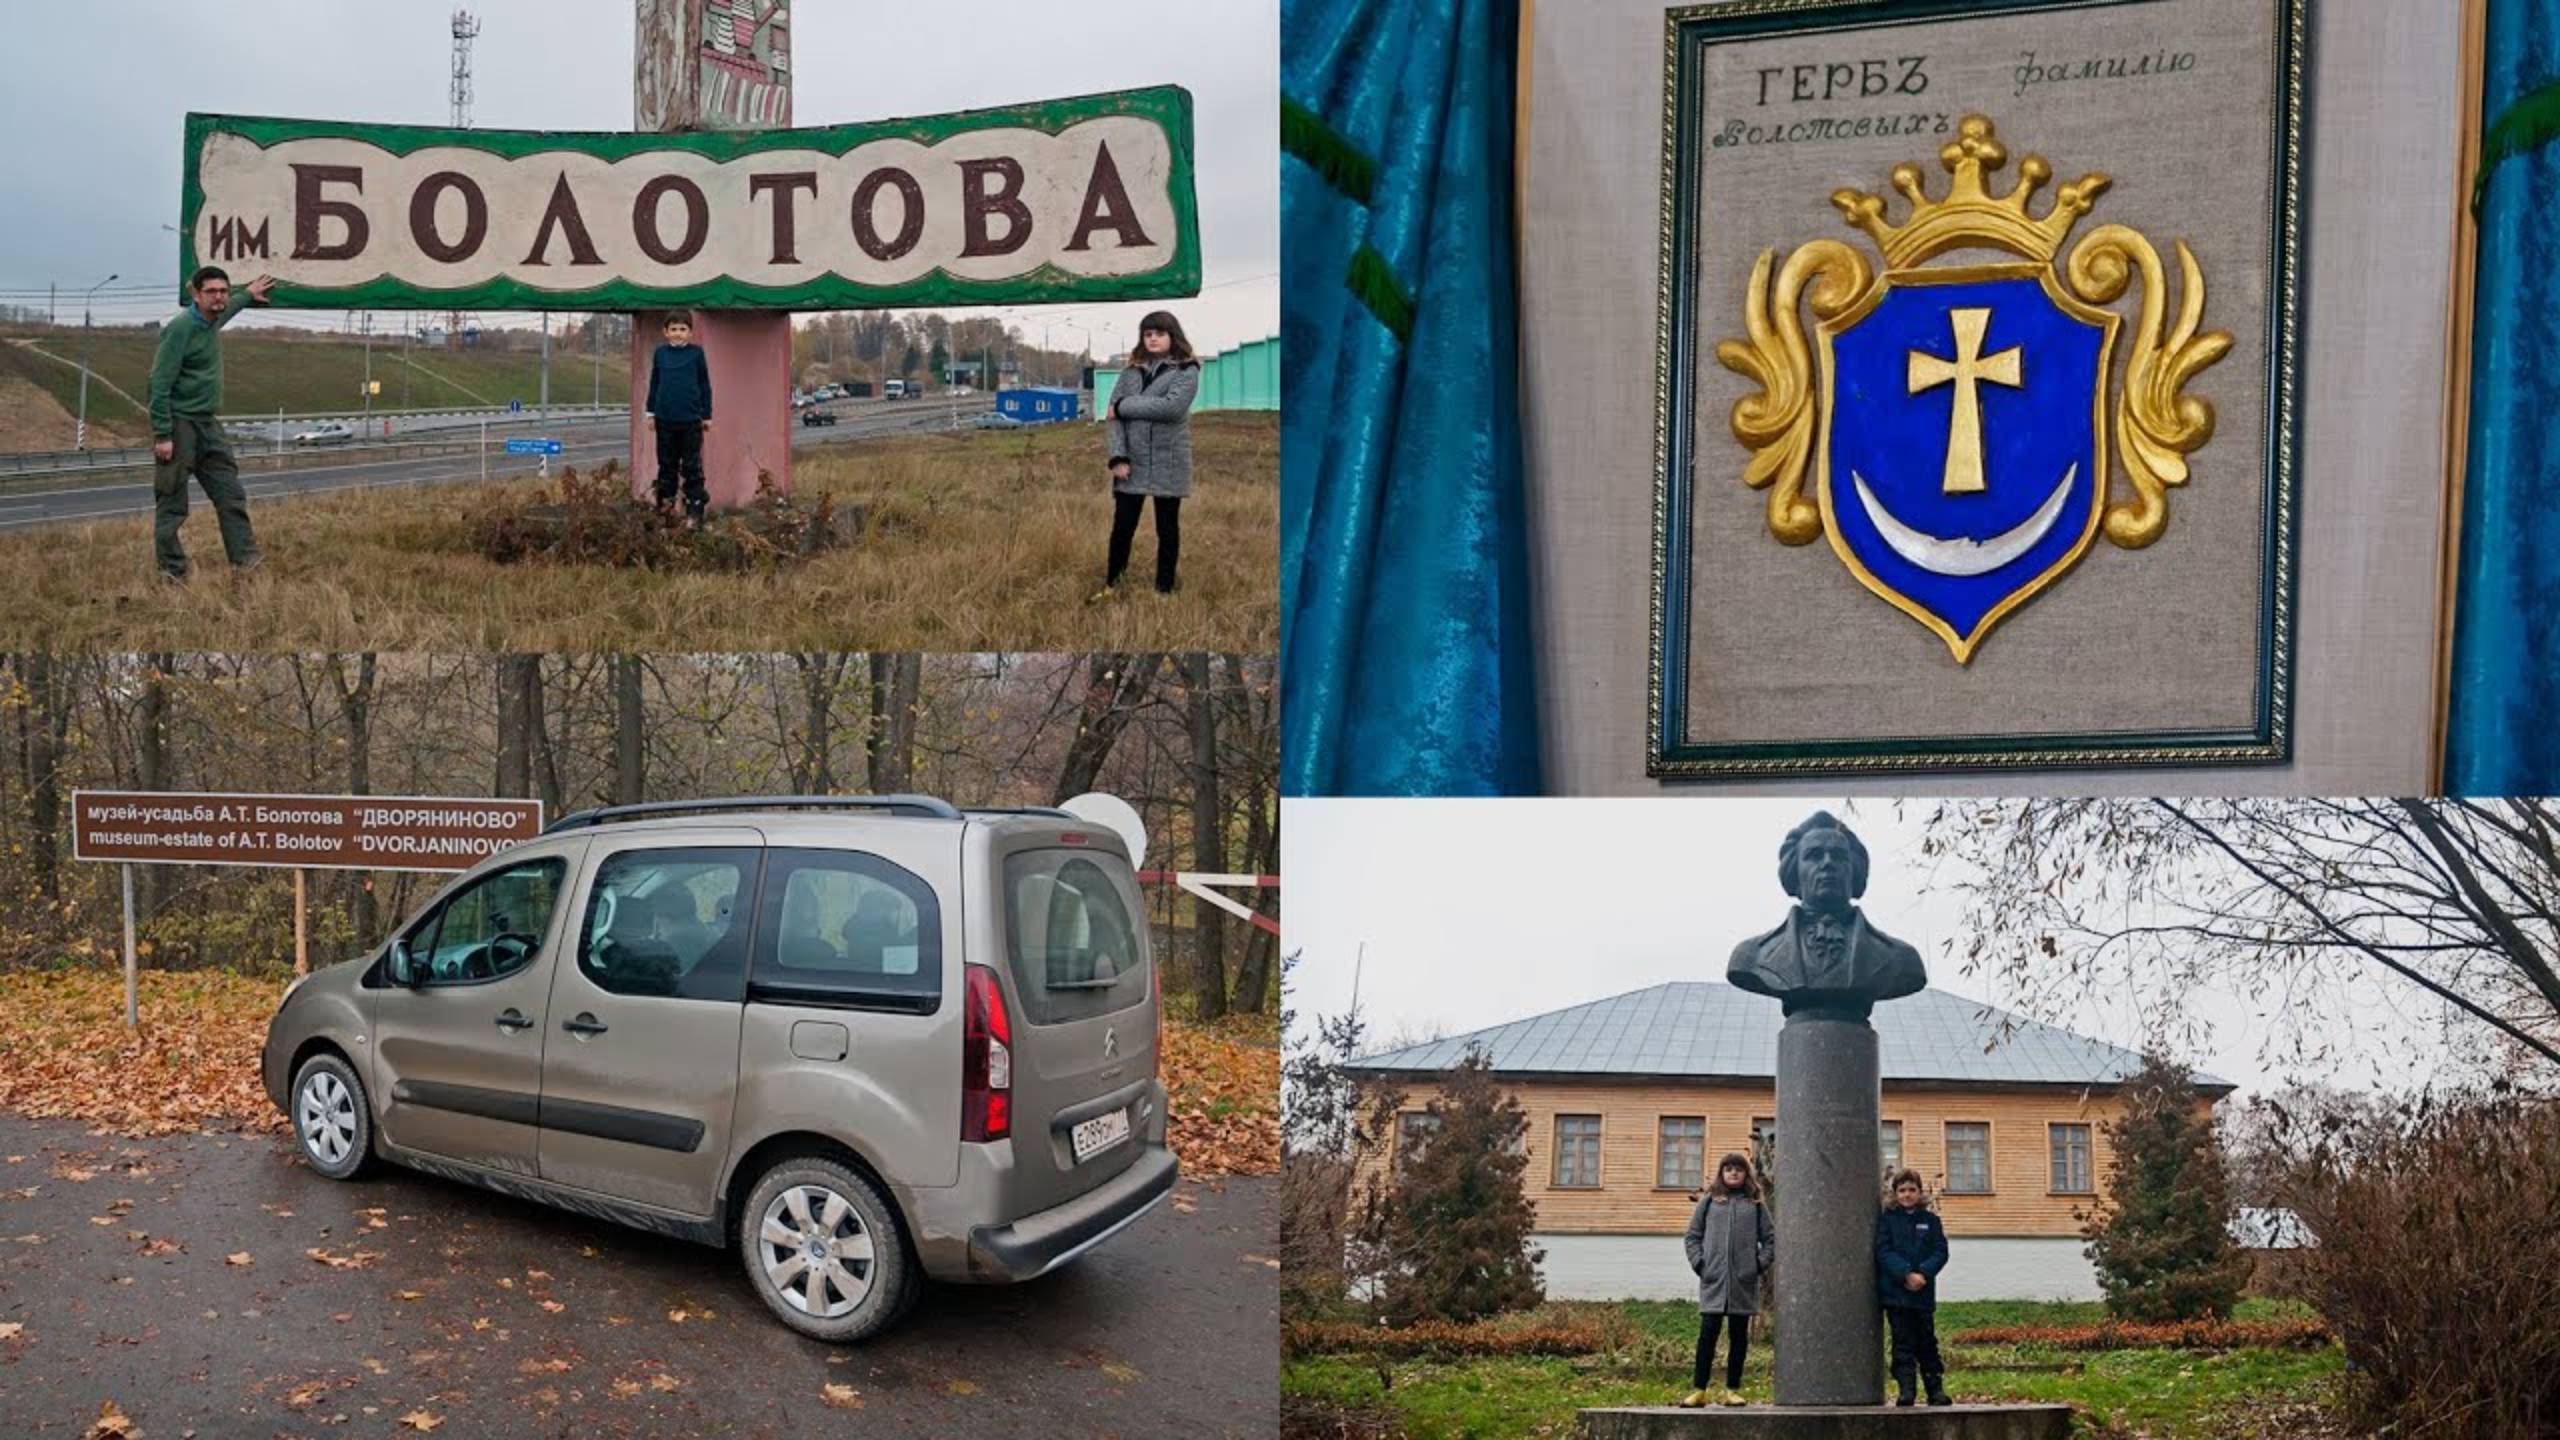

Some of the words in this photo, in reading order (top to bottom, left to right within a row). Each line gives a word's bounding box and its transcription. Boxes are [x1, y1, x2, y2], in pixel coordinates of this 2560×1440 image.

[1757, 56, 1930, 105] ГЕРБЪ
[289, 138, 1157, 265] БОЛОТОВА
[87, 804, 214, 824] музей-усадьба
[255, 807, 343, 824] Болотова
[89, 830, 214, 848] museum-estate
[218, 832, 236, 848] of
[275, 833, 343, 850] Bolotov
